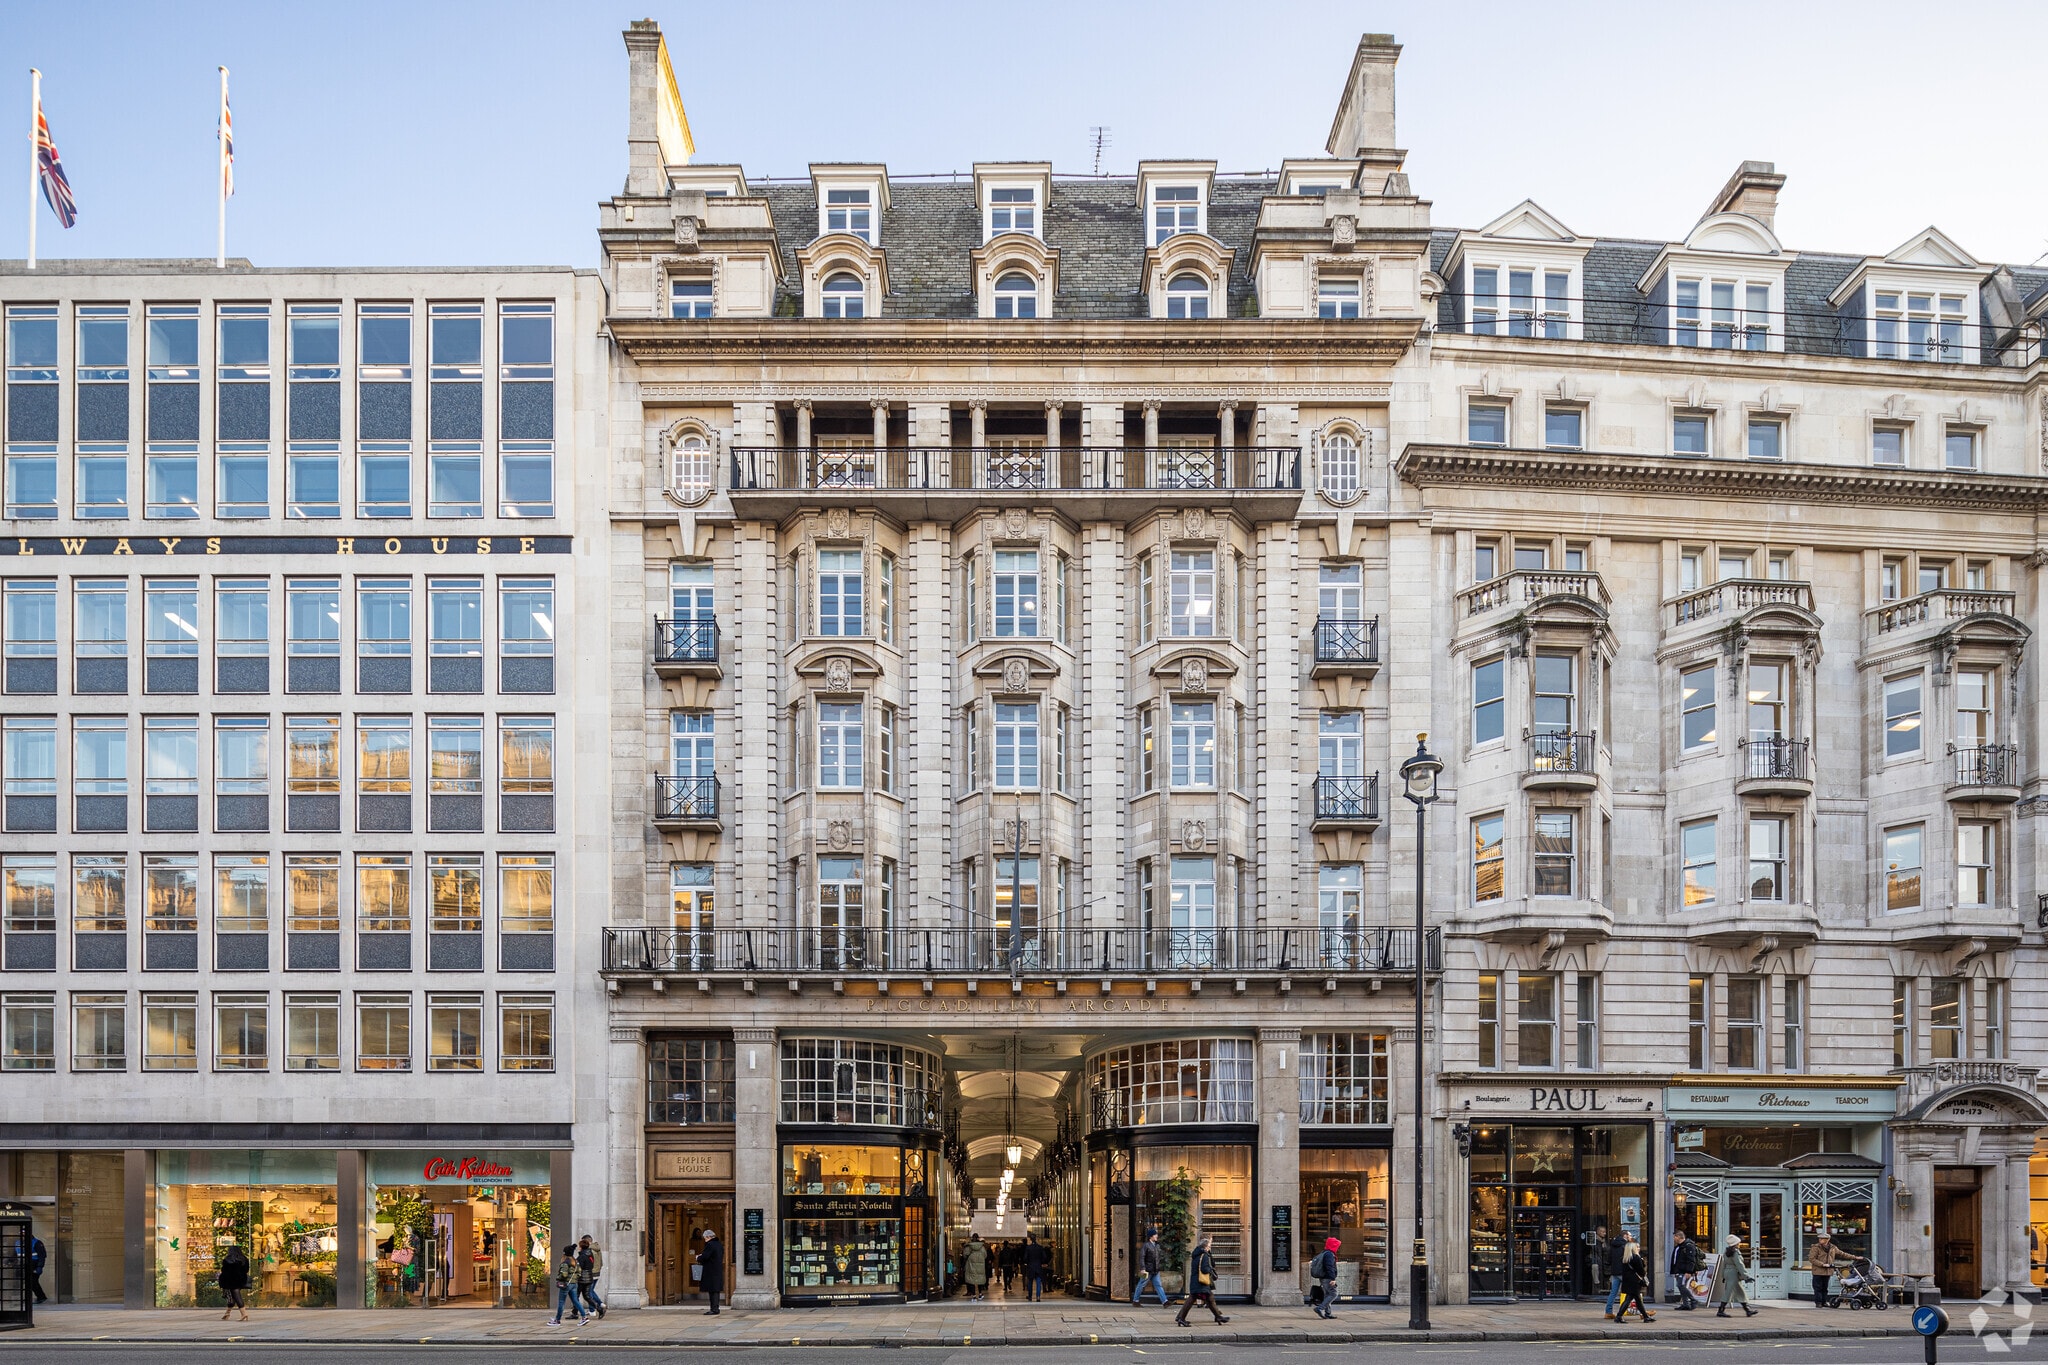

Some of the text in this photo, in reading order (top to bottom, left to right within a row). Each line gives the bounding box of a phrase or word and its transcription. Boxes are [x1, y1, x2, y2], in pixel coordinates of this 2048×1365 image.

[337, 537, 535, 555] HOUSE
[867, 999, 1169, 1012] PICCADILLY ARCADE
[1475, 1095, 1511, 1103] Boulangerie
[1530, 1087, 1607, 1111] PAUL
[1690, 1092, 1869, 1107] RESTAURANT Richoux TEAROOM
[1936, 1099, 1969, 1112] EGYPTIAN
[1723, 1134, 1783, 1150] Richoux
[676, 1156, 712, 1164] EMPIRE
[423, 1156, 513, 1181] Cath Kidston
[678, 1165, 710, 1173] HOUSE
[794, 1200, 893, 1212] Santa Maria Novella
[615, 1219, 633, 1231] 175
